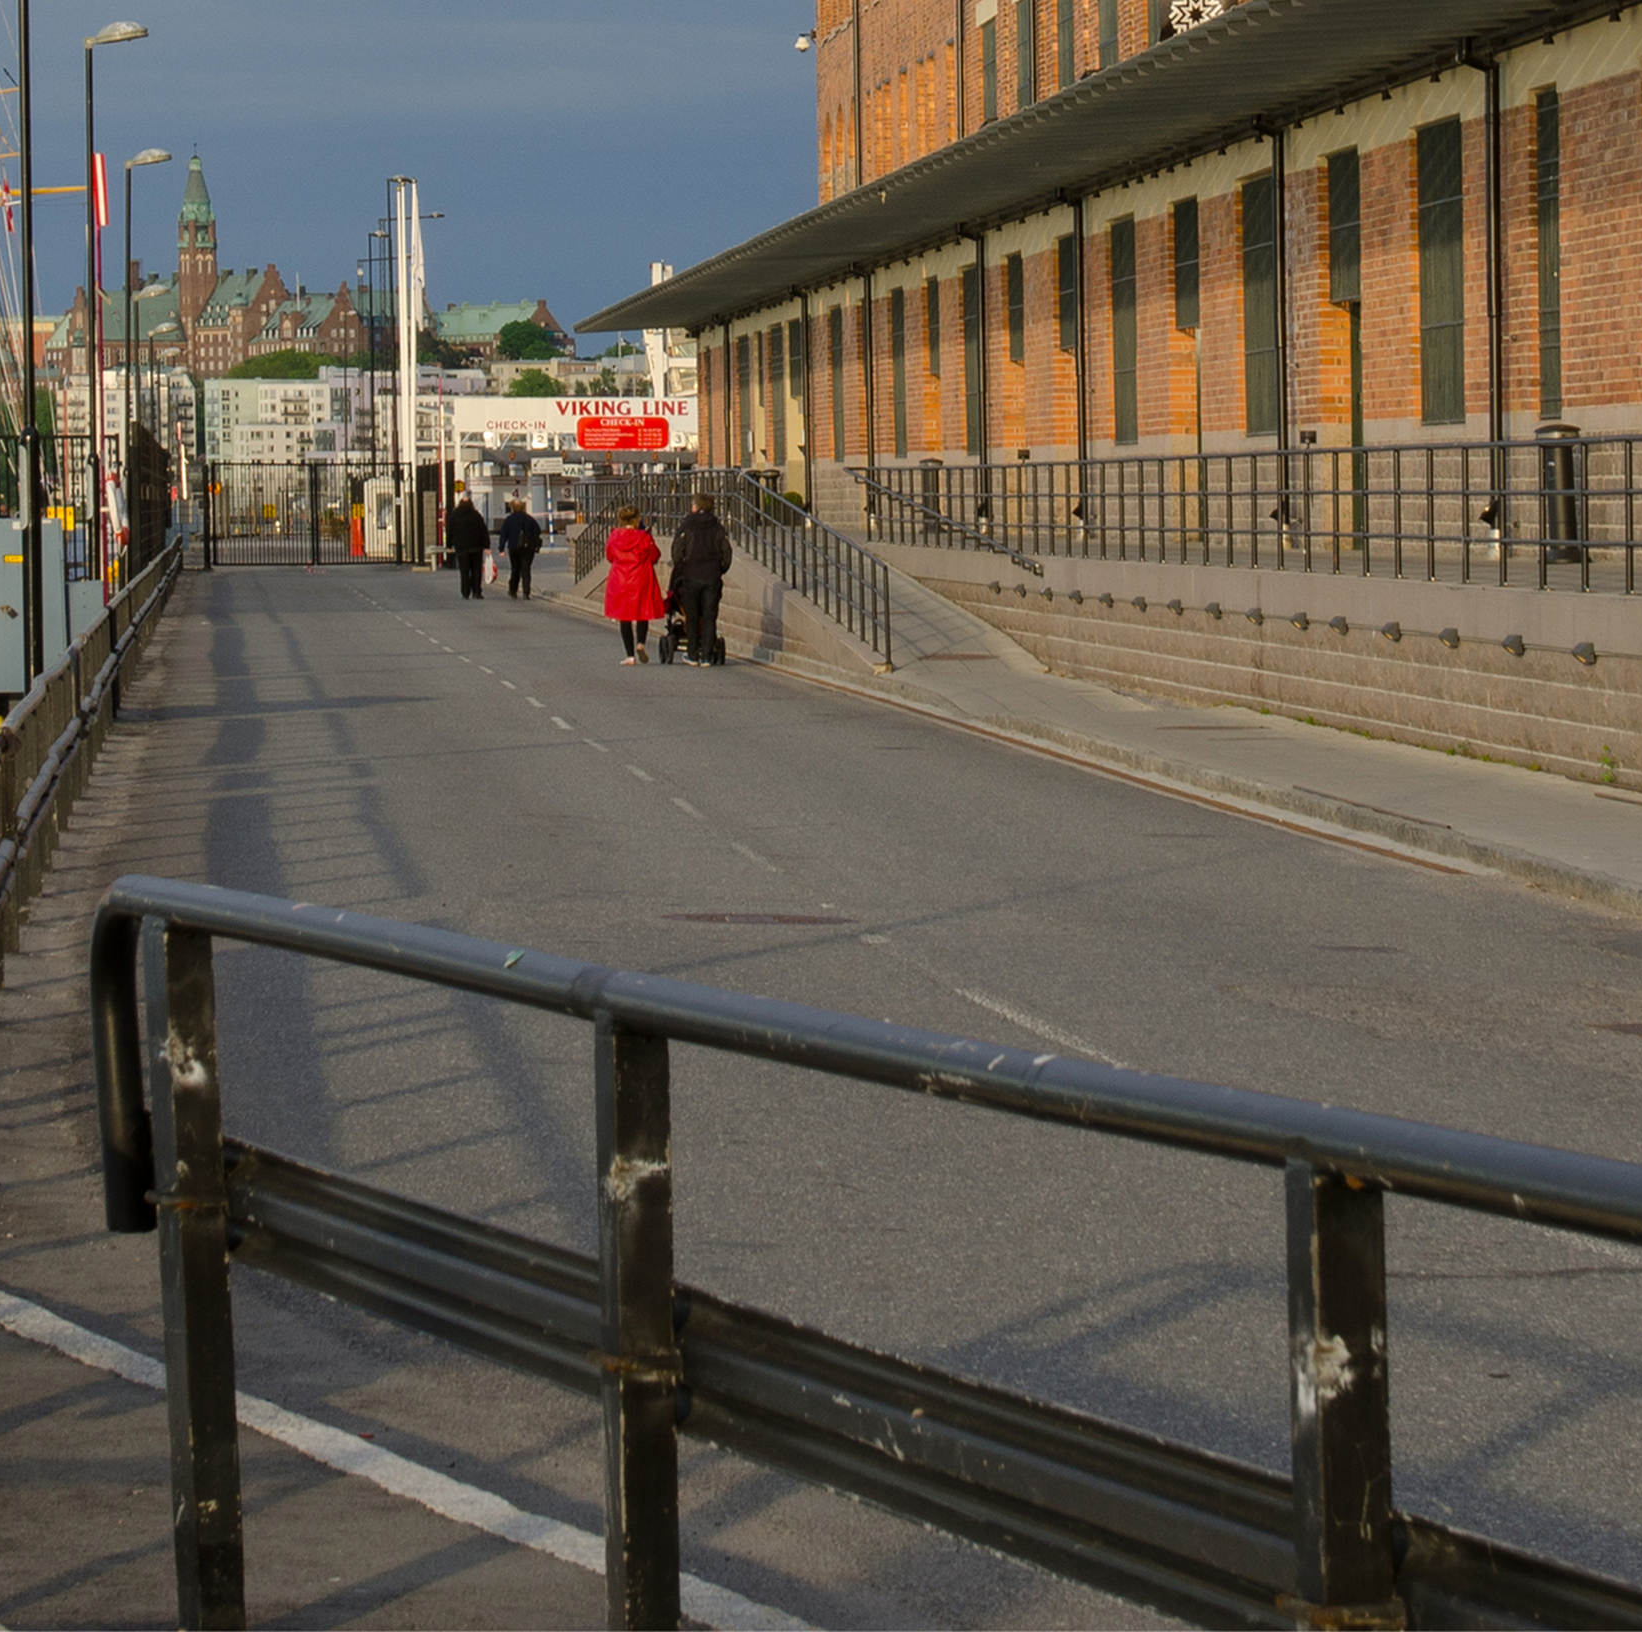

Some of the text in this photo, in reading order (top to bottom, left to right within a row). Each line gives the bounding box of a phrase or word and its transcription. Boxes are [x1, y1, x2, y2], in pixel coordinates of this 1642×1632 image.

[555, 400, 689, 416] VIKING LINE
[486, 420, 546, 430] CHECK-IN
[600, 419, 645, 427] CHECK-IN
[512, 488, 520, 499] 4
[564, 488, 572, 499] 3
